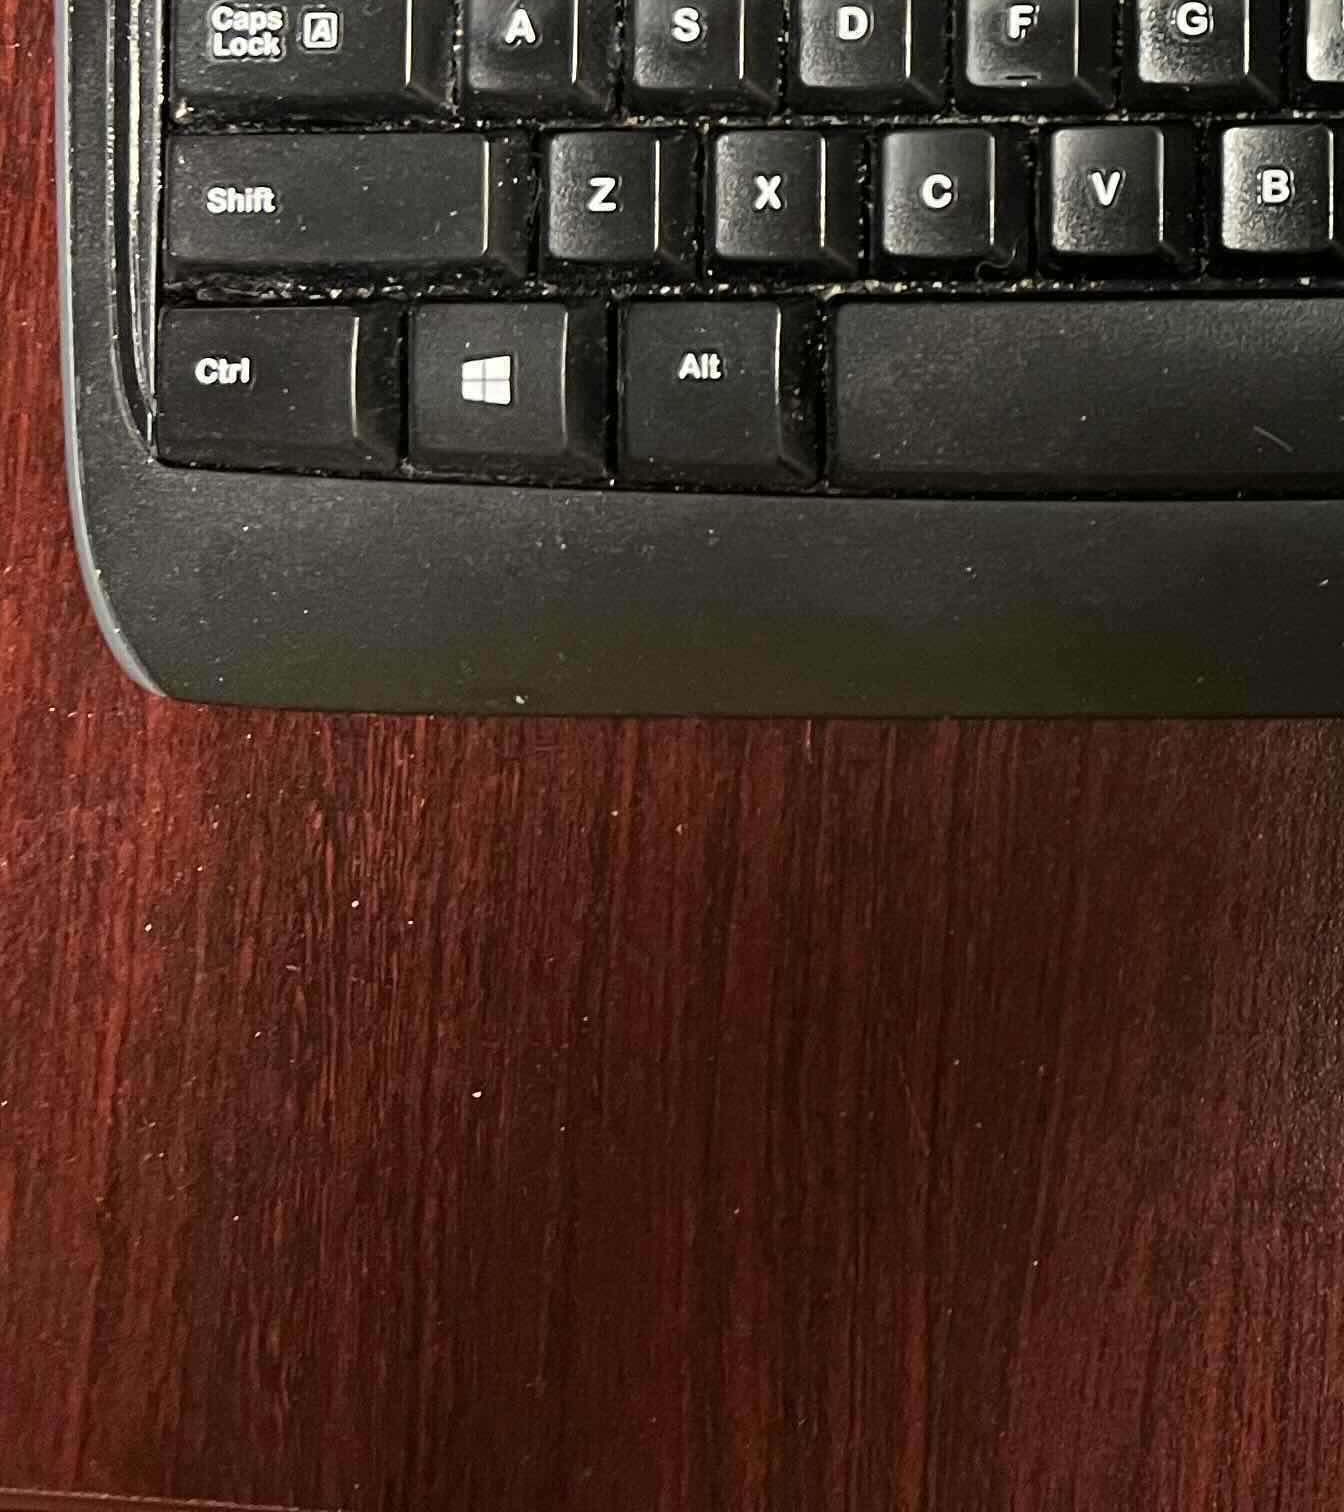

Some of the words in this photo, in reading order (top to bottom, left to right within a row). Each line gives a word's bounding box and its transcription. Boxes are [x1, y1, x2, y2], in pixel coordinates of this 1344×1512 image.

[211, 7, 282, 36] Caps
[506, 10, 535, 44] A
[672, 8, 701, 42] S
[838, 8, 869, 39] D
[1008, 7, 1033, 38] F
[1176, 2, 1208, 36] G
[214, 32, 281, 58] Lock
[207, 187, 275, 213] Shift
[589, 178, 617, 210] Z
[755, 177, 782, 209] X
[923, 175, 952, 208] C
[1091, 173, 1121, 205] V
[1262, 170, 1291, 202] B
[196, 358, 249, 383] Ctrl
[679, 354, 721, 378] Alt
